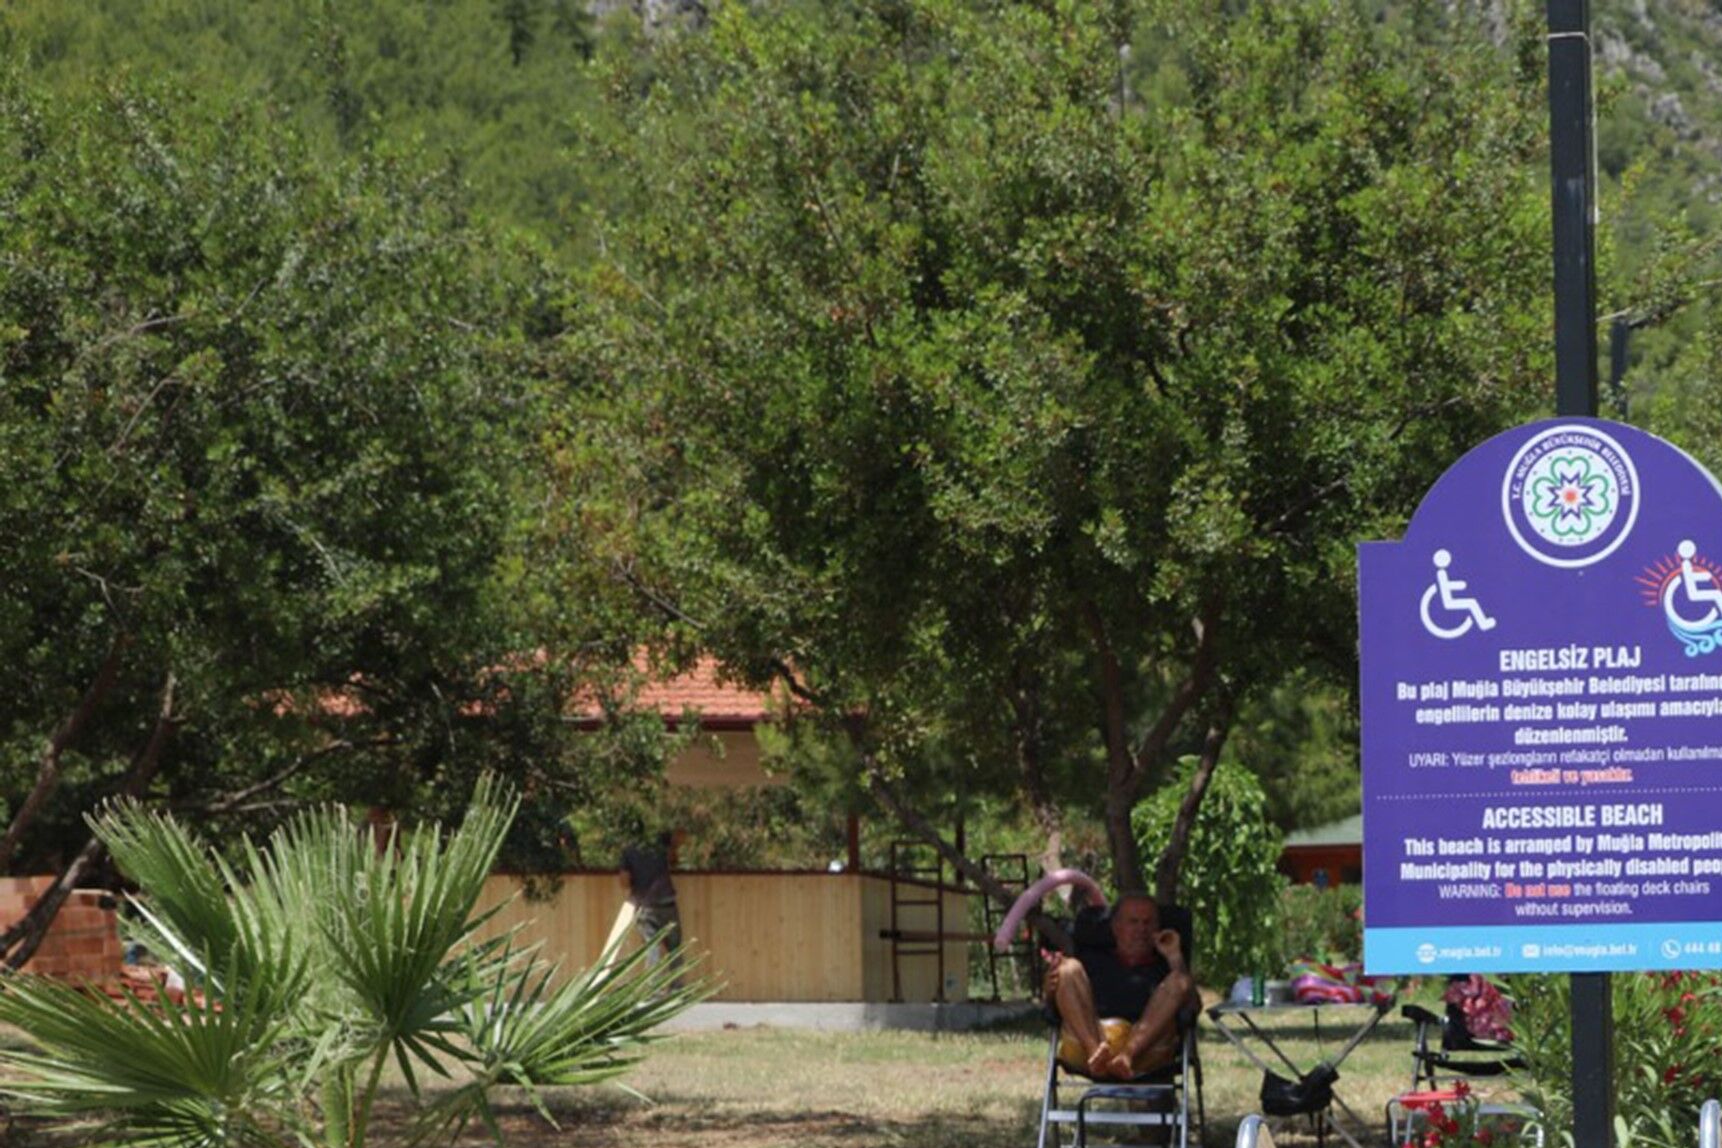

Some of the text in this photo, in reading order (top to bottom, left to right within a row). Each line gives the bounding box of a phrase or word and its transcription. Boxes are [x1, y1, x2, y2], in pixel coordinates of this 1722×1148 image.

[1499, 644, 1642, 672] ENGELSİZ PLAJ
[1396, 681, 1418, 700] Bu
[1420, 681, 1449, 701] plaj
[1452, 680, 1499, 700] Muğla
[1502, 677, 1585, 698] Büyükşehir
[1588, 675, 1666, 695] Belediyesi
[1415, 704, 1501, 726] engellilerin
[1503, 703, 1553, 721] denize
[1556, 702, 1598, 721] kolay
[1600, 700, 1656, 720] ulaşımı
[1514, 725, 1629, 745] düzenlenmiştir.
[1408, 752, 1450, 768] UYARI:
[1451, 751, 1485, 767] Yüzer
[1559, 748, 1611, 766] refakatçi
[1612, 747, 1665, 762] olmadan
[1482, 803, 1664, 830] ACCESSIBLE BEACH
[1403, 837, 1435, 856] This
[1438, 836, 1484, 855] beach
[1487, 837, 1502, 853] is
[1504, 835, 1572, 855] arranged
[1575, 834, 1594, 854] by
[1597, 833, 1645, 853] Muğla
[1400, 861, 1492, 881] Municipality
[1494, 860, 1516, 878] for
[1519, 860, 1543, 878] the
[1547, 858, 1622, 879] physically
[1625, 857, 1690, 875] disabled
[1438, 883, 1503, 899] WARNING:
[1504, 882, 1523, 898] Do
[1524, 882, 1546, 898] not
[1573, 882, 1592, 896] the
[1594, 881, 1639, 898] floating
[1641, 880, 1671, 895] deck
[1673, 879, 1711, 895] chairs
[1514, 900, 1634, 918] without supervision.
